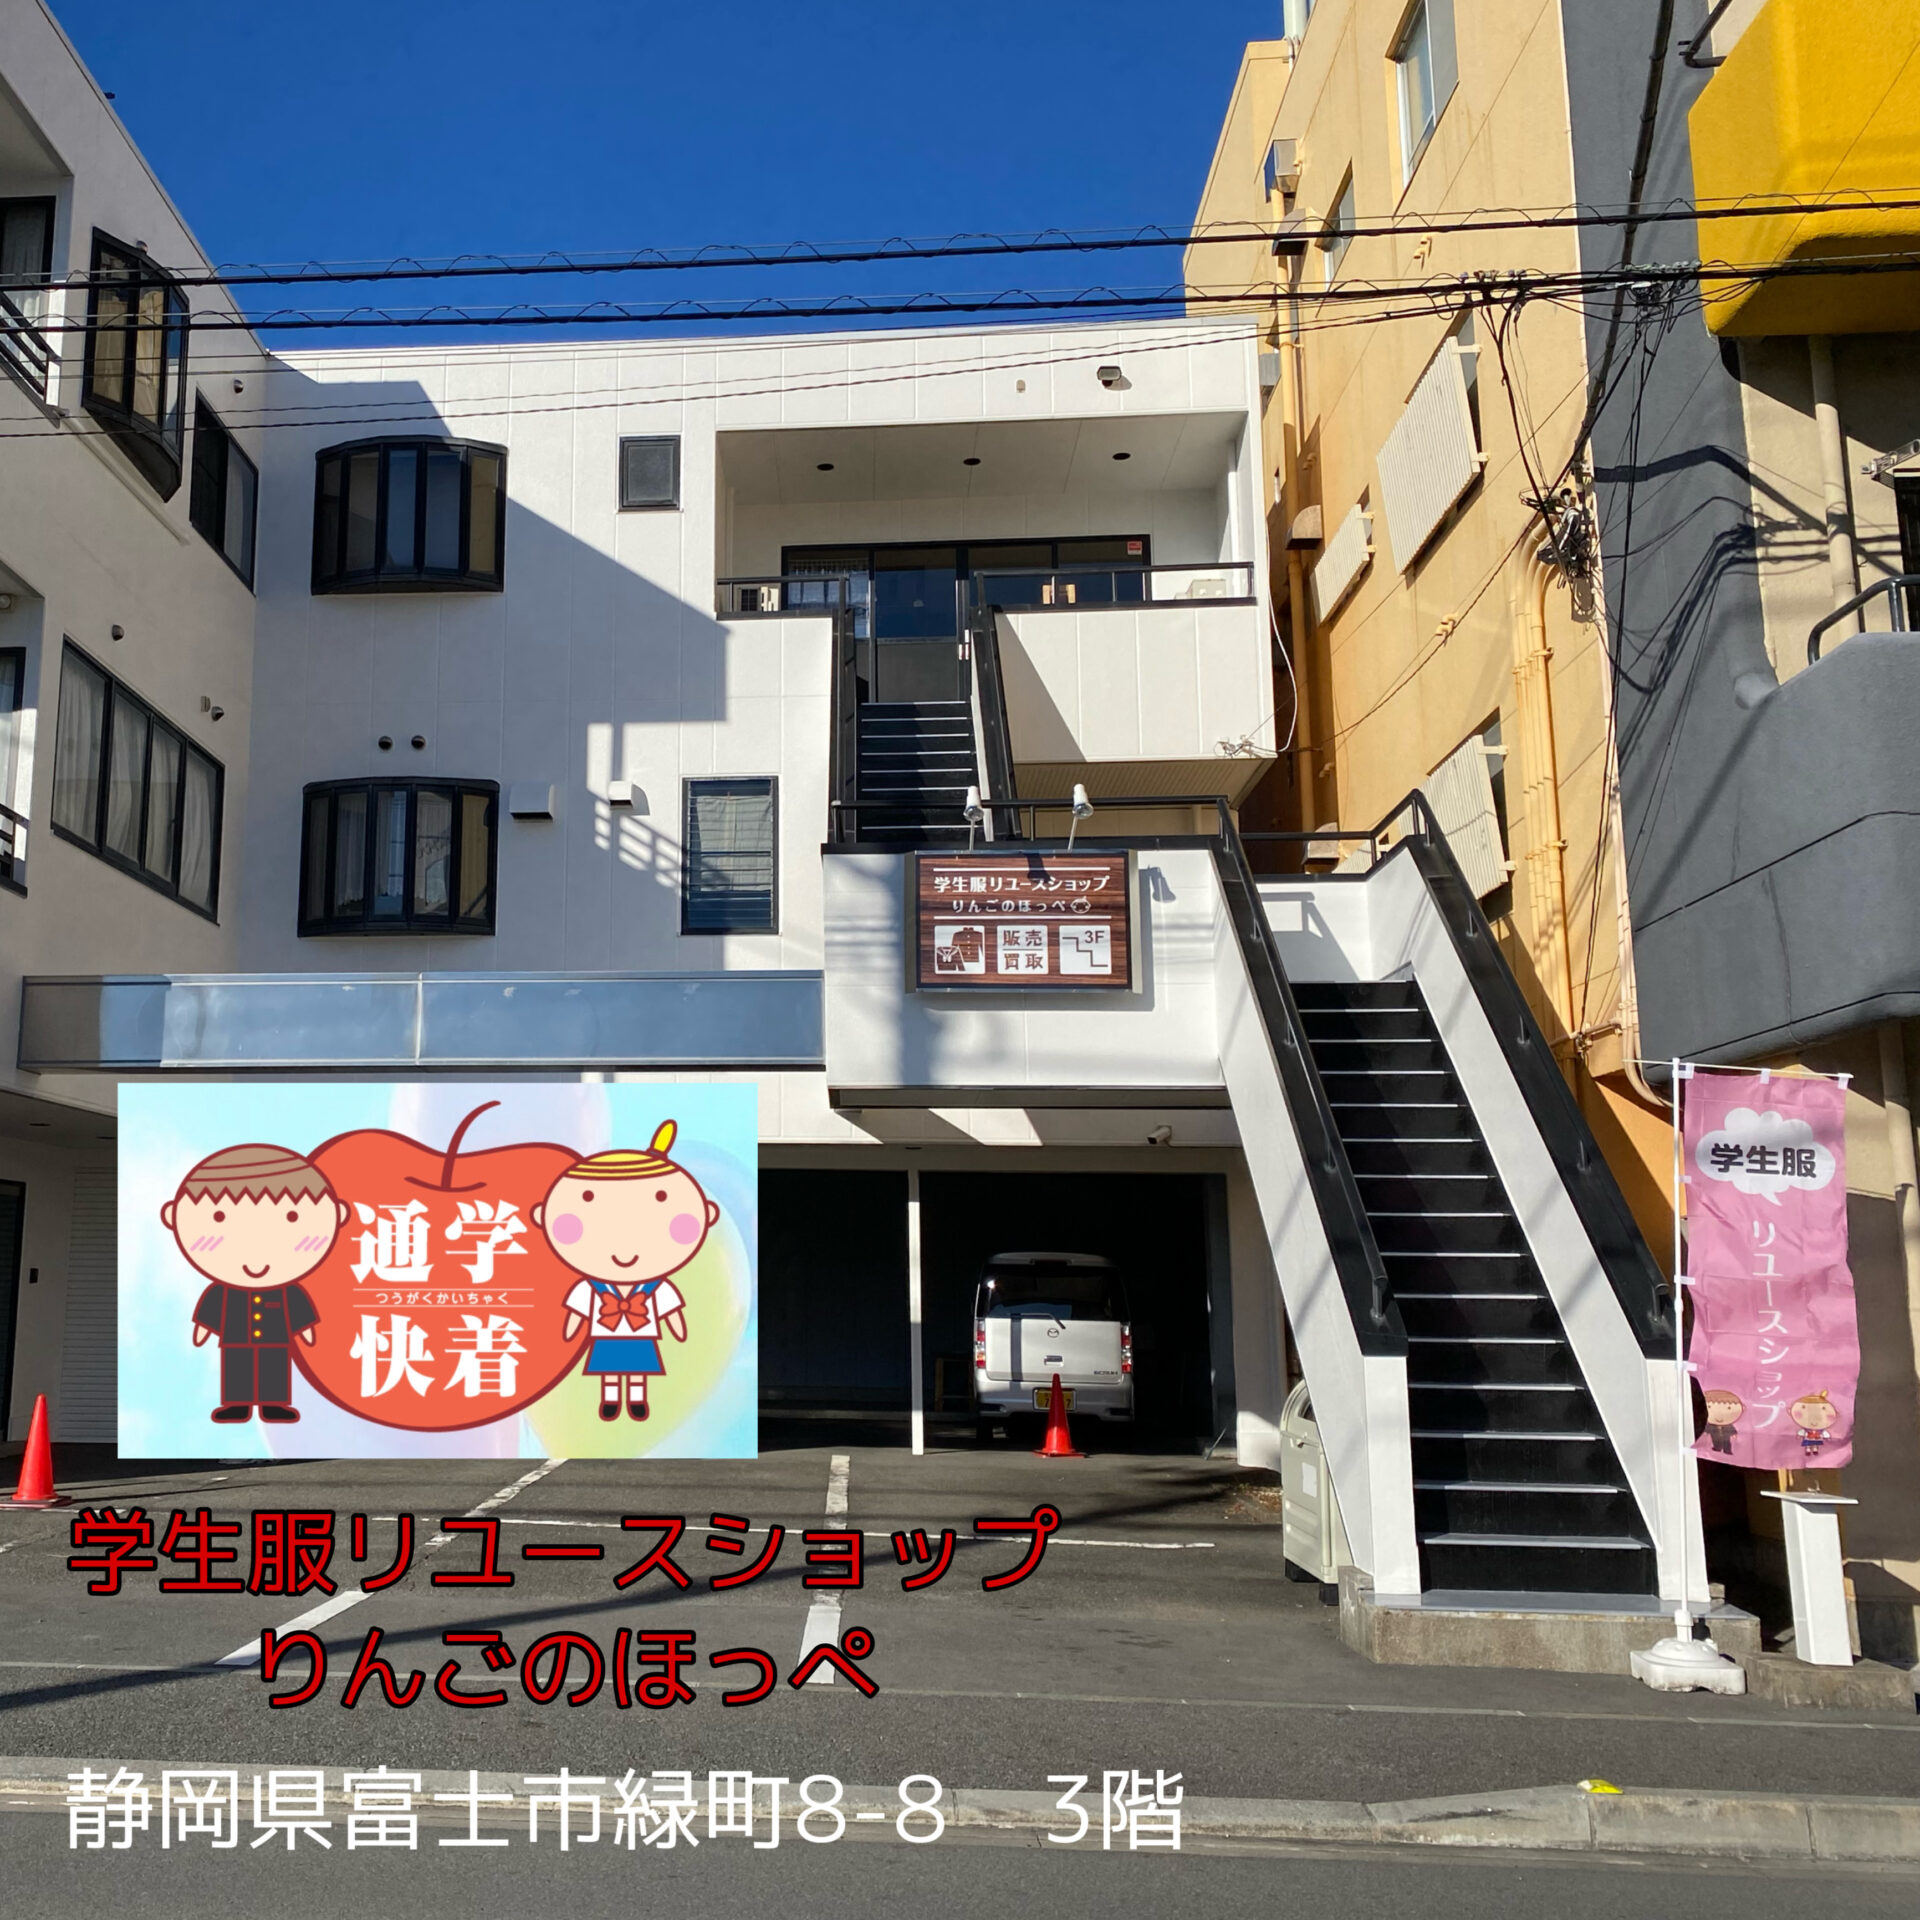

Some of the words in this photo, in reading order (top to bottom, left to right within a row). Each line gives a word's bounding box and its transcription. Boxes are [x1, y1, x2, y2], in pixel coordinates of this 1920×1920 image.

[933, 875, 1110, 893] 学生服リユースショップ
[951, 899, 1066, 913] りんごのほっぺ
[1003, 929, 1042, 946] 販売
[1084, 931, 1105, 944] 3F
[1004, 953, 1043, 970] 買取
[1710, 1142, 1817, 1178] 学生服
[1751, 1220, 1789, 1430] リユースショップ
